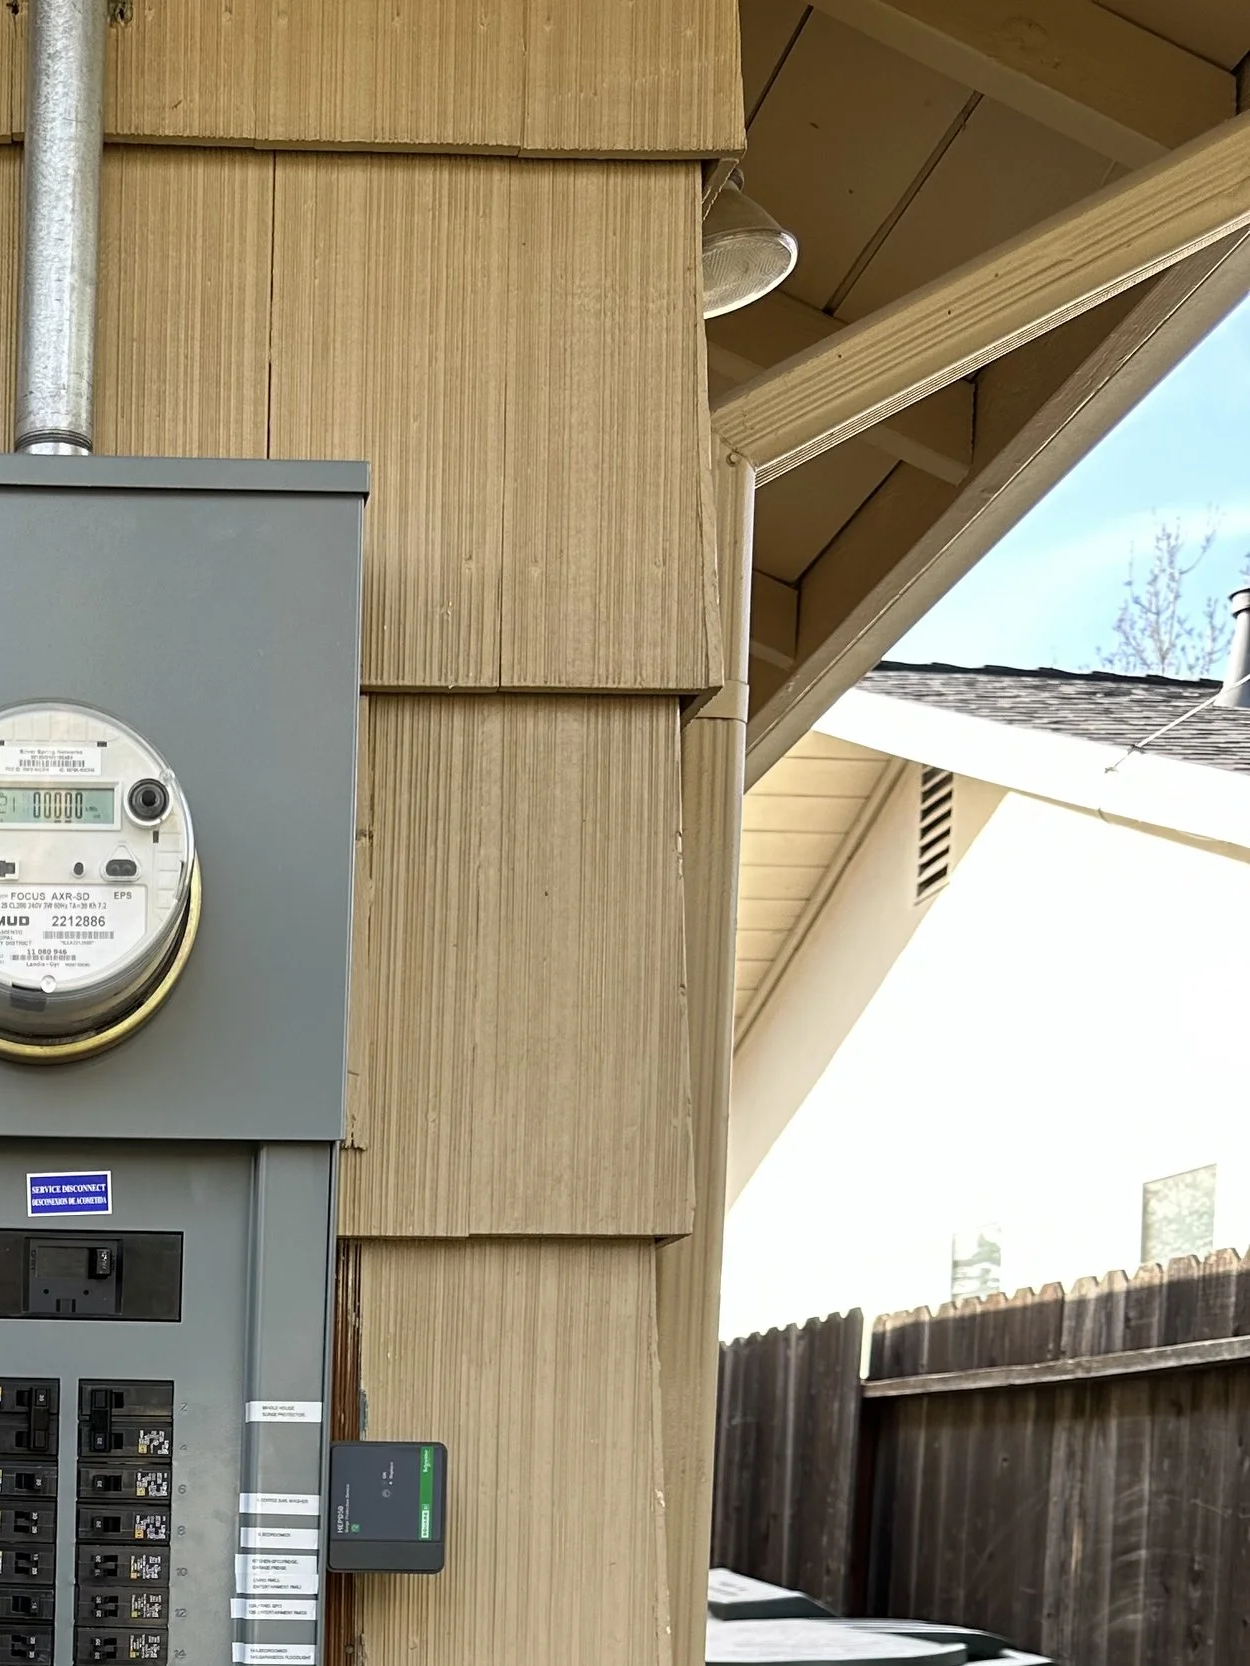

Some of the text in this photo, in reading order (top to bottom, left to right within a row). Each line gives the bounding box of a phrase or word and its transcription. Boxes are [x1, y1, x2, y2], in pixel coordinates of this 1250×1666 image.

[10, 892, 46, 901] FOCUS
[51, 892, 90, 900] AXR-SD
[114, 891, 132, 900] EPS
[51, 915, 106, 927] 2212886
[32, 1183, 106, 1195] SERVICE DISCONNECT
